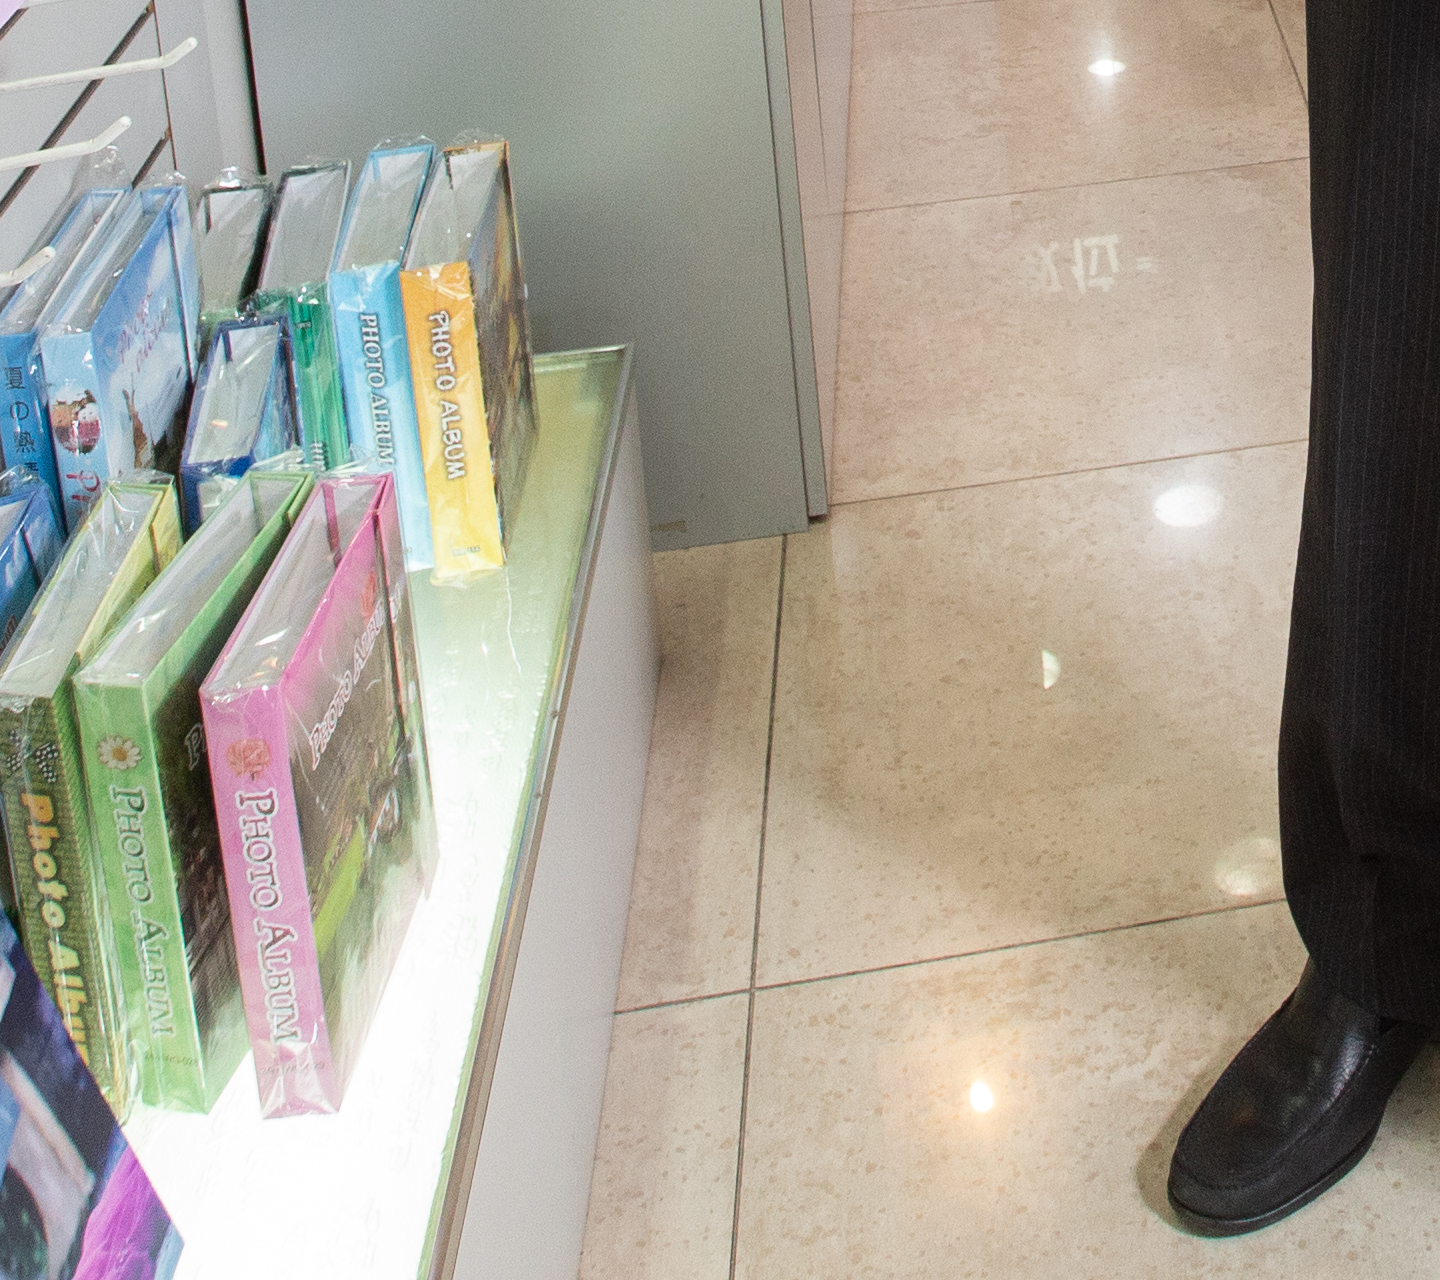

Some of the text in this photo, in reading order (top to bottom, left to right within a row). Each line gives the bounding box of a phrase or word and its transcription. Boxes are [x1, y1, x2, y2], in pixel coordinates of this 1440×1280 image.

[359, 312, 396, 467] PHOTO ALBUM
[427, 309, 467, 481] PHOTO ALBUM
[20, 790, 69, 930] Photo
